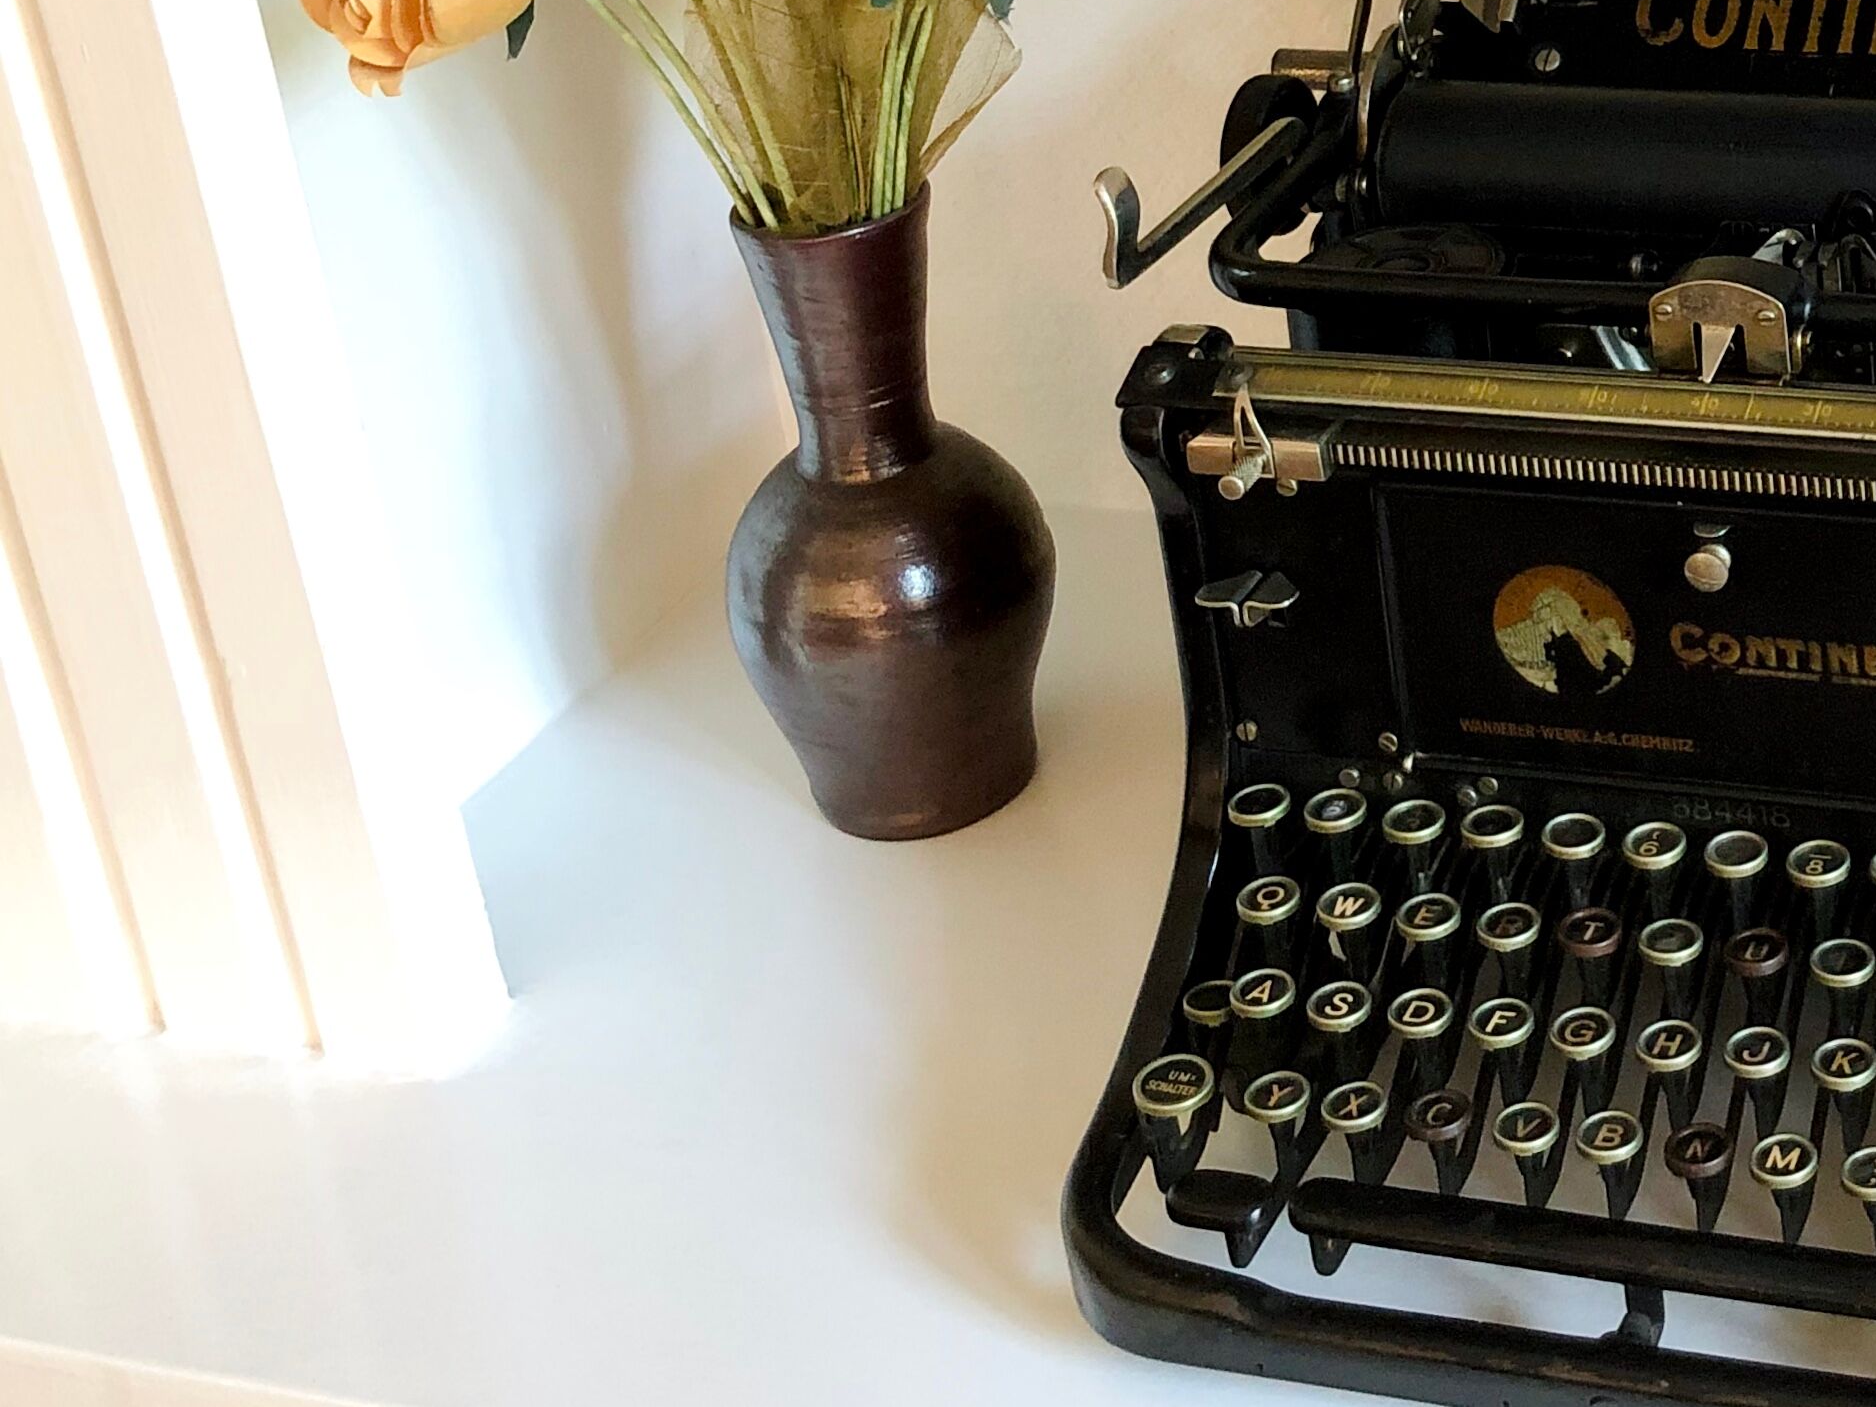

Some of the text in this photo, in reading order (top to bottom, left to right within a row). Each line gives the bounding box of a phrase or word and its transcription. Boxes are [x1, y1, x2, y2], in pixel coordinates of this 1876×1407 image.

[1638, 841, 1660, 856] 6
[1805, 859, 1825, 875] 8
[1256, 885, 1285, 911] Q
[1333, 895, 1365, 918] W
[1414, 904, 1444, 926] E
[1582, 921, 1604, 942] T
[1246, 980, 1274, 1004] A
[1324, 992, 1354, 1017] S
[1402, 1000, 1436, 1023] D
[1484, 1010, 1518, 1034] F
[1563, 1019, 1597, 1043] G
[1652, 1032, 1684, 1057] H
[1742, 1041, 1771, 1064] J
[1830, 1051, 1858, 1073] K
[1268, 1083, 1295, 1107] Y
[1338, 1092, 1369, 1117] X
[1426, 1102, 1453, 1125] C
[1516, 1115, 1542, 1139] V
[1592, 1123, 1625, 1148] B
[1764, 1145, 1802, 1171] M
